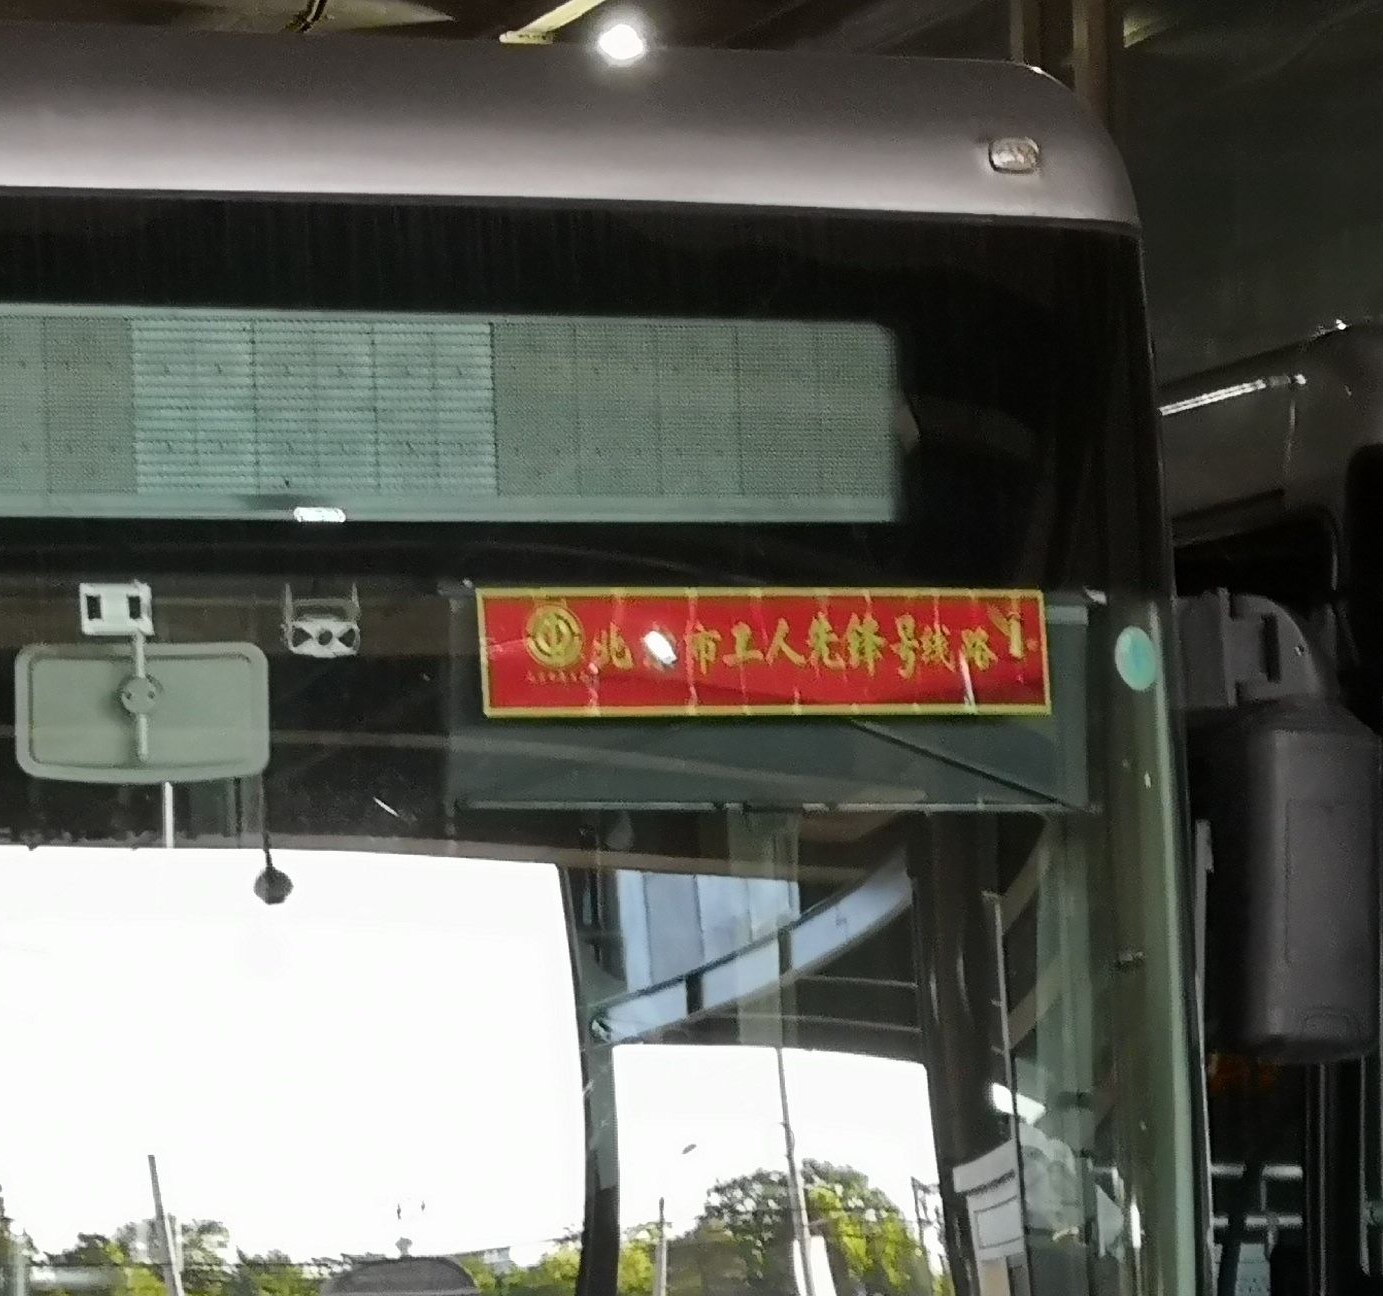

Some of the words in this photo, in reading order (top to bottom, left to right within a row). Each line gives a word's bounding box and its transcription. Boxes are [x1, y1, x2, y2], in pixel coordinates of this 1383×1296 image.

[590, 610, 998, 680] 北市工人先锋号线路
